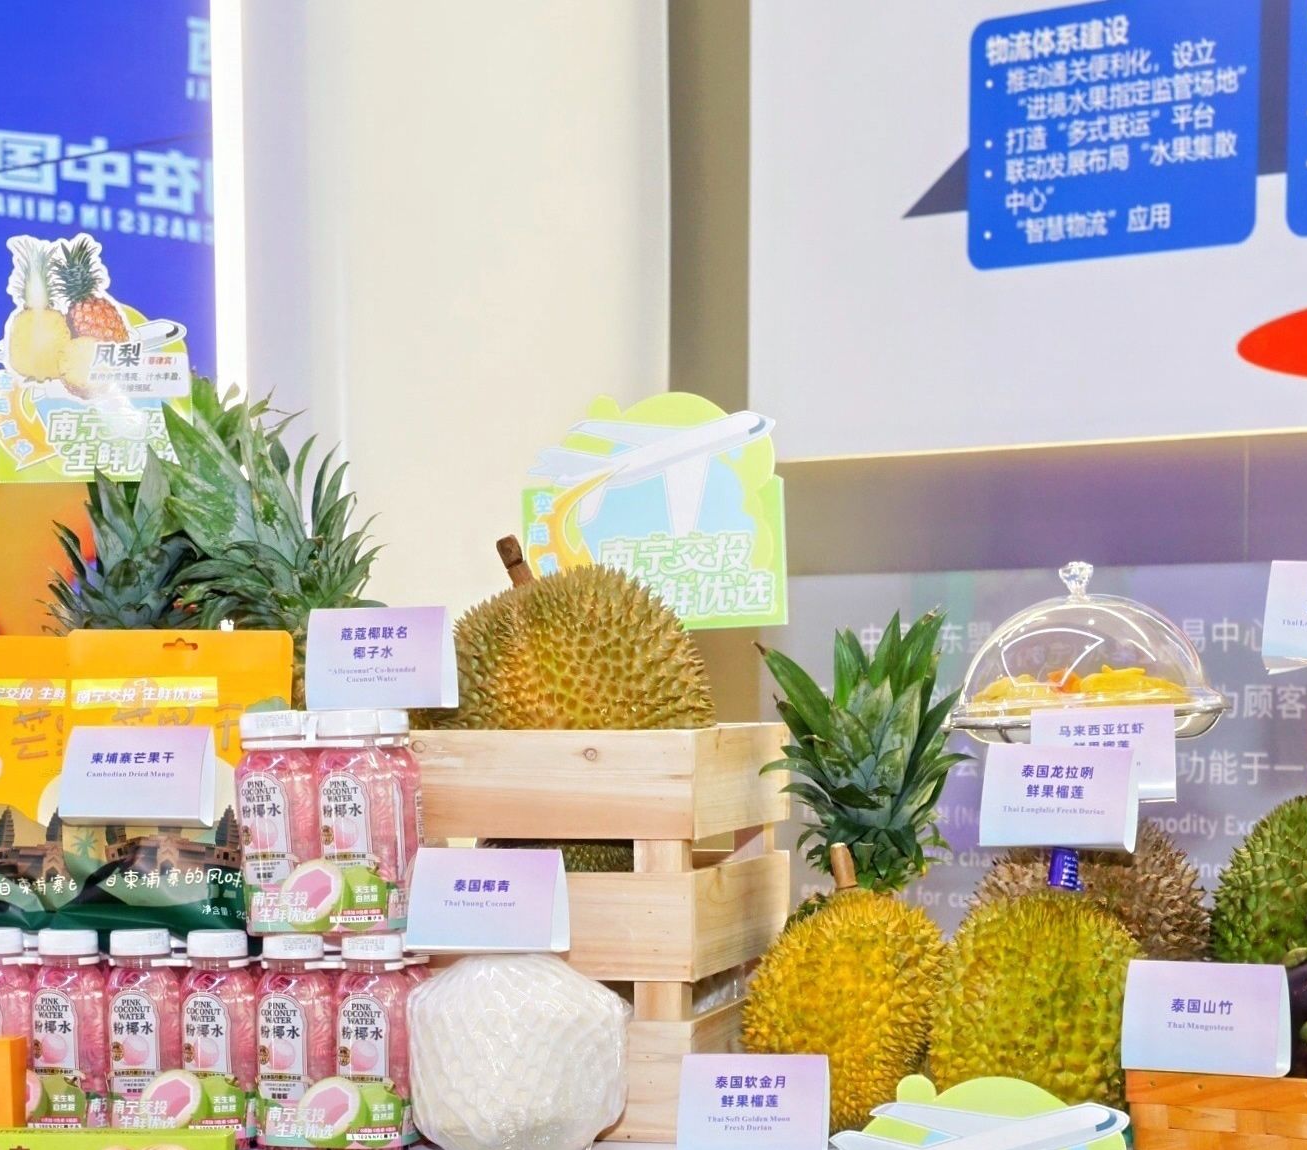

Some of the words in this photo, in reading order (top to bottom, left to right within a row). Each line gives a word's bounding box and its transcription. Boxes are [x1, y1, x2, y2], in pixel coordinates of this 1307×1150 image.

[986, 15, 1129, 66] 物流体系建设
[93, 342, 142, 368] 凤梨
[599, 534, 753, 575] 南宁交投
[341, 626, 408, 641] 蔻蔻椰联名
[353, 646, 393, 660] 椰子水
[76, 688, 136, 705] 南宁交投
[142, 686, 203, 701] 生鲜优选
[1059, 722, 1145, 737] 马来西亚红虾
[91, 752, 175, 765] 柬埔寨芒果干
[149, 771, 175, 779] Mango
[241, 787, 277, 796] COCONUT
[1026, 784, 1085, 800] 鲜果榴莲
[242, 803, 282, 818] 粉椰水
[323, 803, 362, 818] 粉椰水
[454, 879, 510, 892] 泰国椰青
[462, 900, 484, 908] Young
[1171, 998, 1233, 1015] 泰国山竹
[1187, 1022, 1234, 1031] Mangosteen
[715, 1076, 786, 1089] 泰国软金月
[721, 1095, 779, 1108] 鲜果榴莲
